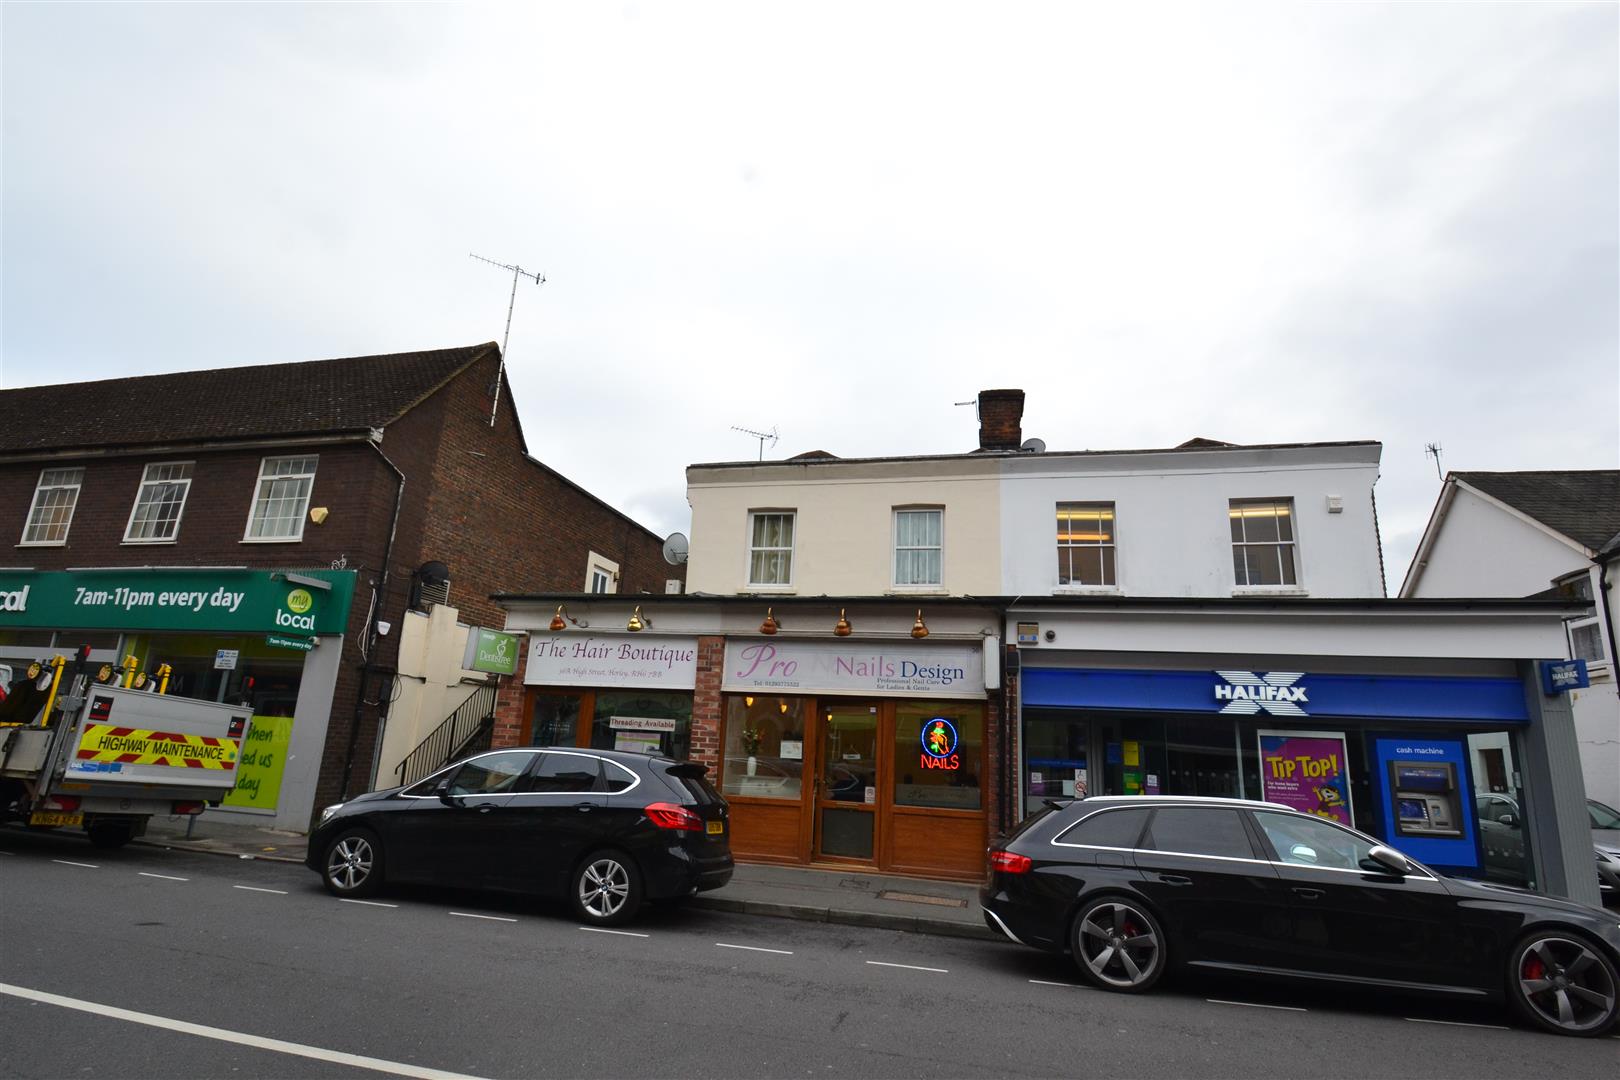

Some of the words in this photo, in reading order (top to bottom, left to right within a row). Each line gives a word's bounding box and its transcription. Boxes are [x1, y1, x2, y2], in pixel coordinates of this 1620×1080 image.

[74, 587, 155, 611] 7am-11pm
[158, 591, 208, 612] every
[210, 586, 245, 613] day
[275, 608, 315, 630] local
[535, 637, 567, 658] The
[572, 637, 613, 659] Hair
[617, 643, 694, 669] Boutique
[736, 642, 798, 678] Pro
[836, 655, 895, 678] Nails
[900, 661, 964, 685] Design
[877, 677, 911, 685] Professional
[1214, 684, 1309, 702] HALIFAX
[611, 718, 642, 727] Threading
[644, 719, 674, 729] Available
[97, 736, 150, 753] HIGHWAY
[152, 741, 224, 760] MAINTENANCE
[1414, 747, 1444, 755] machine
[259, 753, 273, 768] us
[920, 754, 960, 770] NAILS
[238, 773, 261, 800] day
